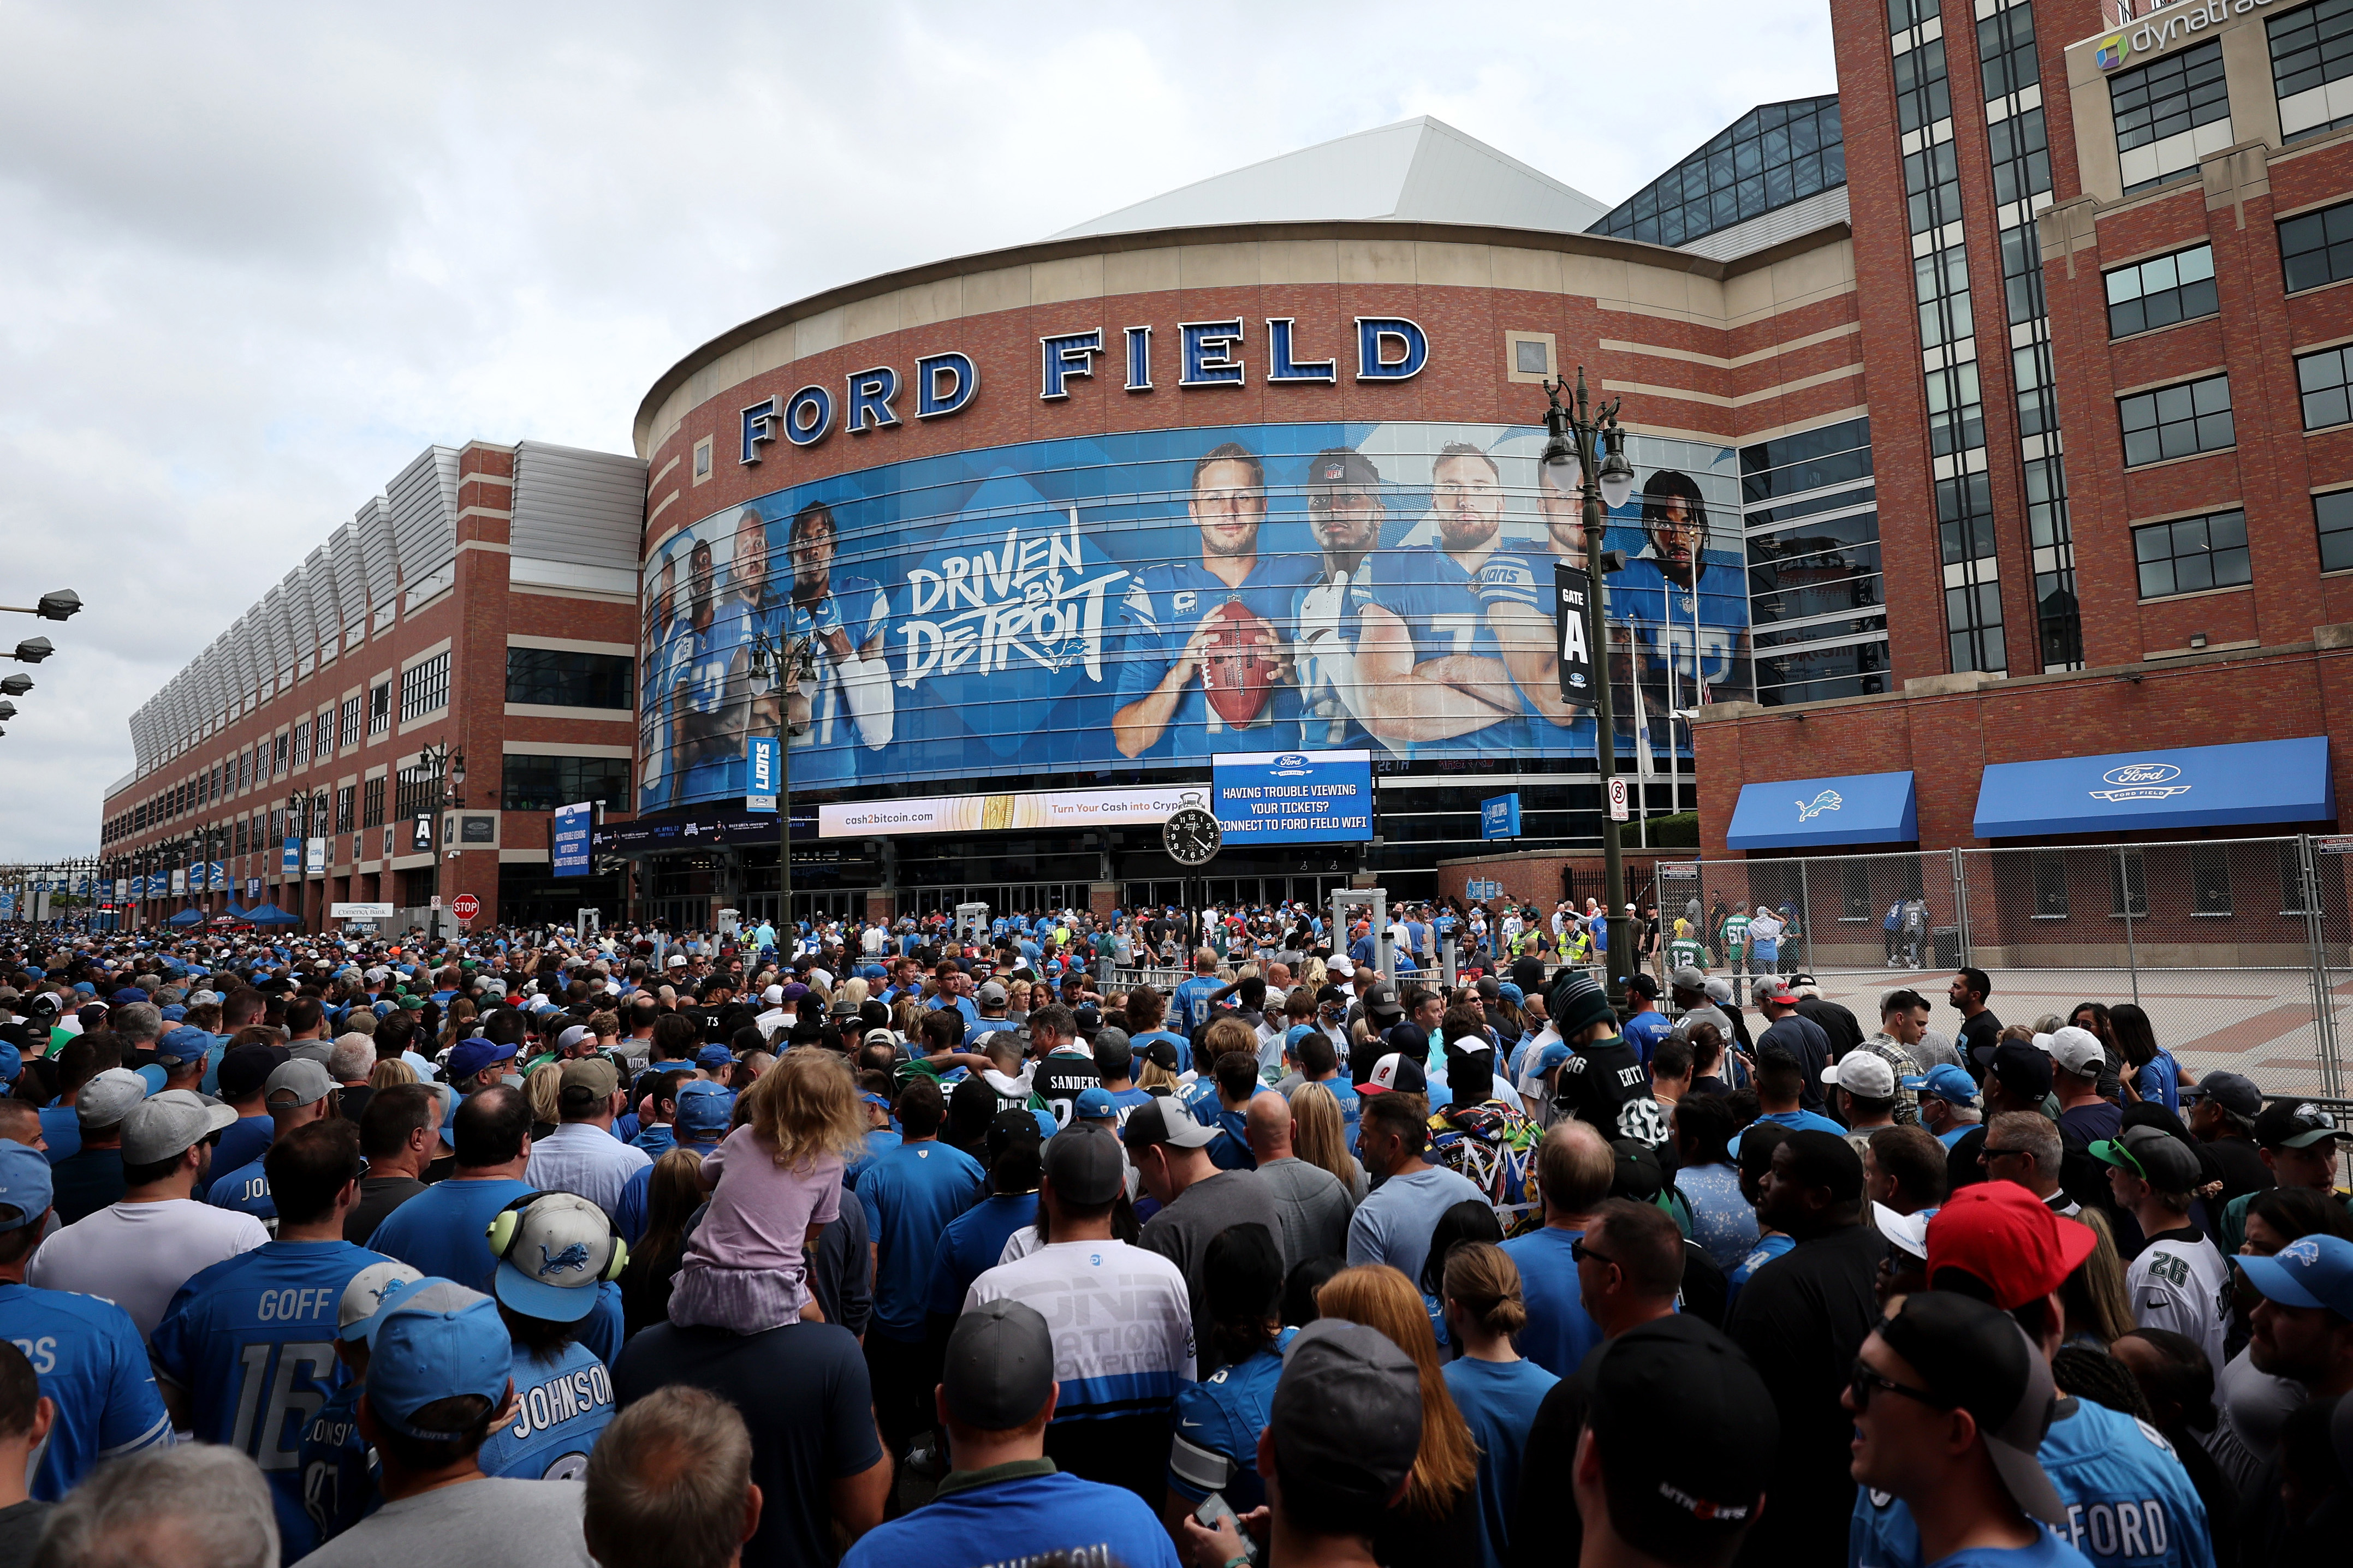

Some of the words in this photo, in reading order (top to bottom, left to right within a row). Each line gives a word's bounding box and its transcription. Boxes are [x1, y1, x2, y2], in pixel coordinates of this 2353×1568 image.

[738, 350, 981, 466] FORD
[1038, 315, 1430, 402] FIELD
[1327, 470, 1340, 479] NFL
[907, 505, 1084, 616] DRIVEN
[1562, 588, 1583, 606] GATE
[896, 569, 1131, 690] DETROIT
[1564, 609, 1589, 665] A
[755, 742, 770, 790] LIONS
[1280, 756, 1302, 766] Ford
[2118, 766, 2166, 782] Ford
[1223, 788, 1261, 799] HAVING
[1265, 785, 1309, 797] TROUBLE
[1311, 784, 1357, 796] VIEWING
[1052, 804, 1074, 814] Turn
[1076, 803, 1099, 813] Your
[1101, 802, 1127, 812] Cash
[1130, 802, 1150, 810] into
[1251, 803, 1278, 814] YOUR
[1280, 801, 1329, 814] TICKETS?
[846, 813, 933, 826] cash2bitcoin.com
[1220, 820, 1263, 832] CONNECT
[1265, 819, 1279, 831] TO
[1281, 818, 1308, 830] FORD
[1311, 817, 1339, 829] FIELD
[1341, 816, 1367, 828] WIFI
[416, 820, 431, 839] A
[454, 902, 477, 913] STOP
[345, 923, 355, 932] VIP
[362, 923, 377, 932] GATE
[995, 925, 1003, 934] 58
[1509, 920, 1521, 934] 20
[1672, 950, 1695, 970] 12
[1193, 999, 1208, 1027] 9
[1674, 1017, 1691, 1029] 97
[1050, 1075, 1101, 1090] SANDERS
[2148, 1250, 2189, 1287] 26
[258, 1288, 333, 1321] GOFF
[231, 1343, 336, 1470] 16
[512, 1363, 614, 1440] JOHNSON
